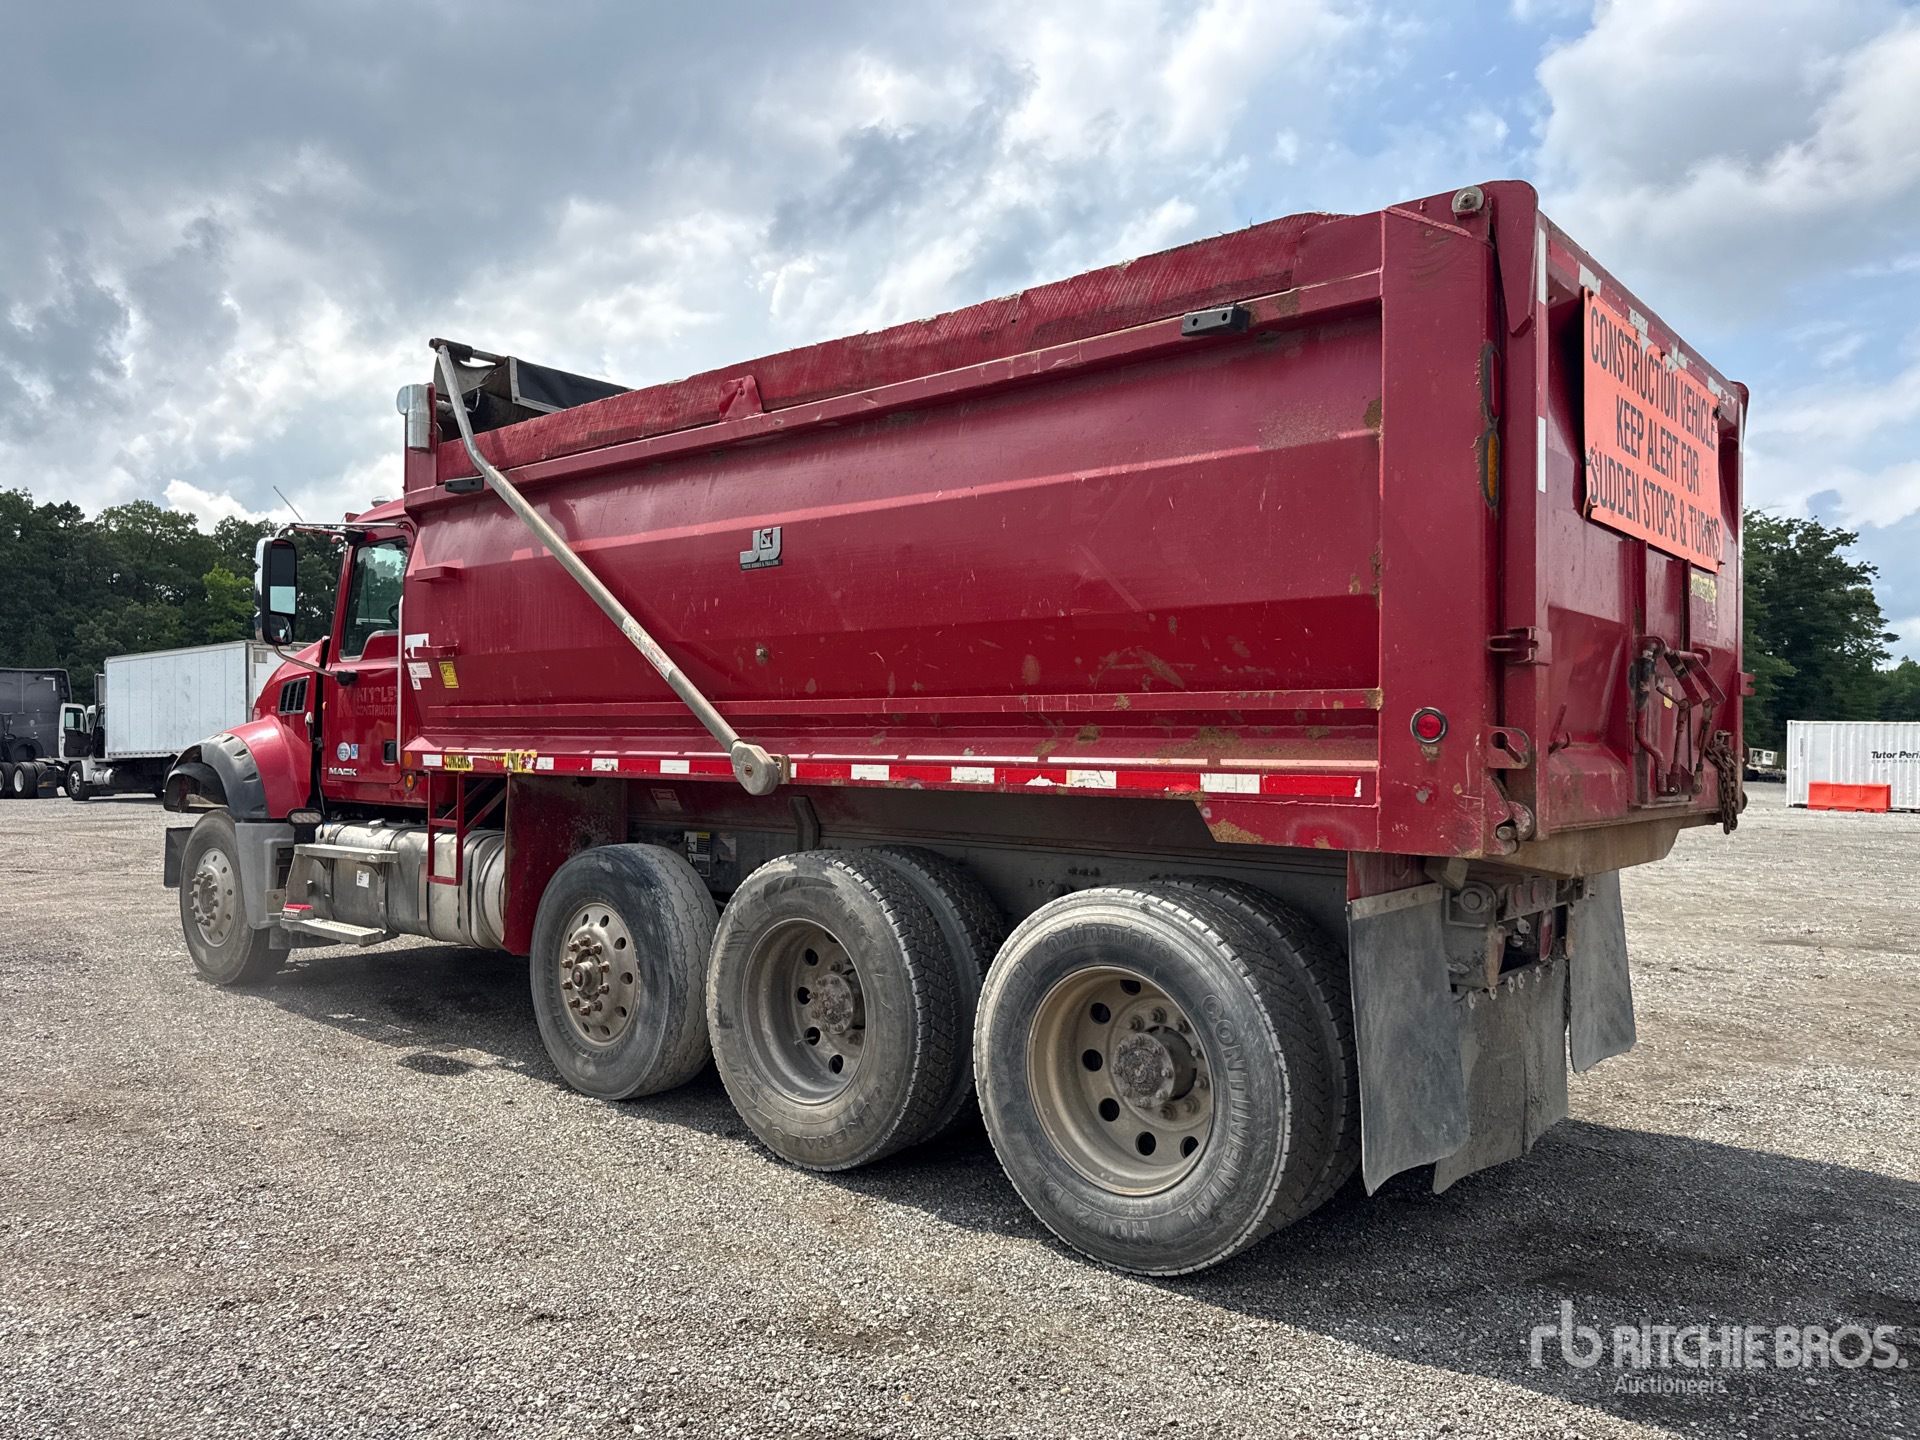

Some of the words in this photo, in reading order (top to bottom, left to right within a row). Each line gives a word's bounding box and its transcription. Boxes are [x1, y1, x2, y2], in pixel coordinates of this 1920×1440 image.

[1590, 306, 1678, 423] CONSTRUCTION
[1680, 380, 1715, 452] VEHICLE
[1616, 394, 1644, 460] KEEP
[1648, 418, 1678, 483] ALERT
[1681, 440, 1699, 497] FOR
[1589, 448, 1640, 525] SUDDEN
[1643, 477, 1677, 542] STOPS
[1679, 499, 1687, 548] &
[1688, 504, 1720, 560] TURNS
[328, 767, 357, 776] MACK
[1871, 750, 1897, 759] Tutor
[1899, 750, 1920, 759] Peri
[1179, 994, 1251, 1226] CONTINENTAL
